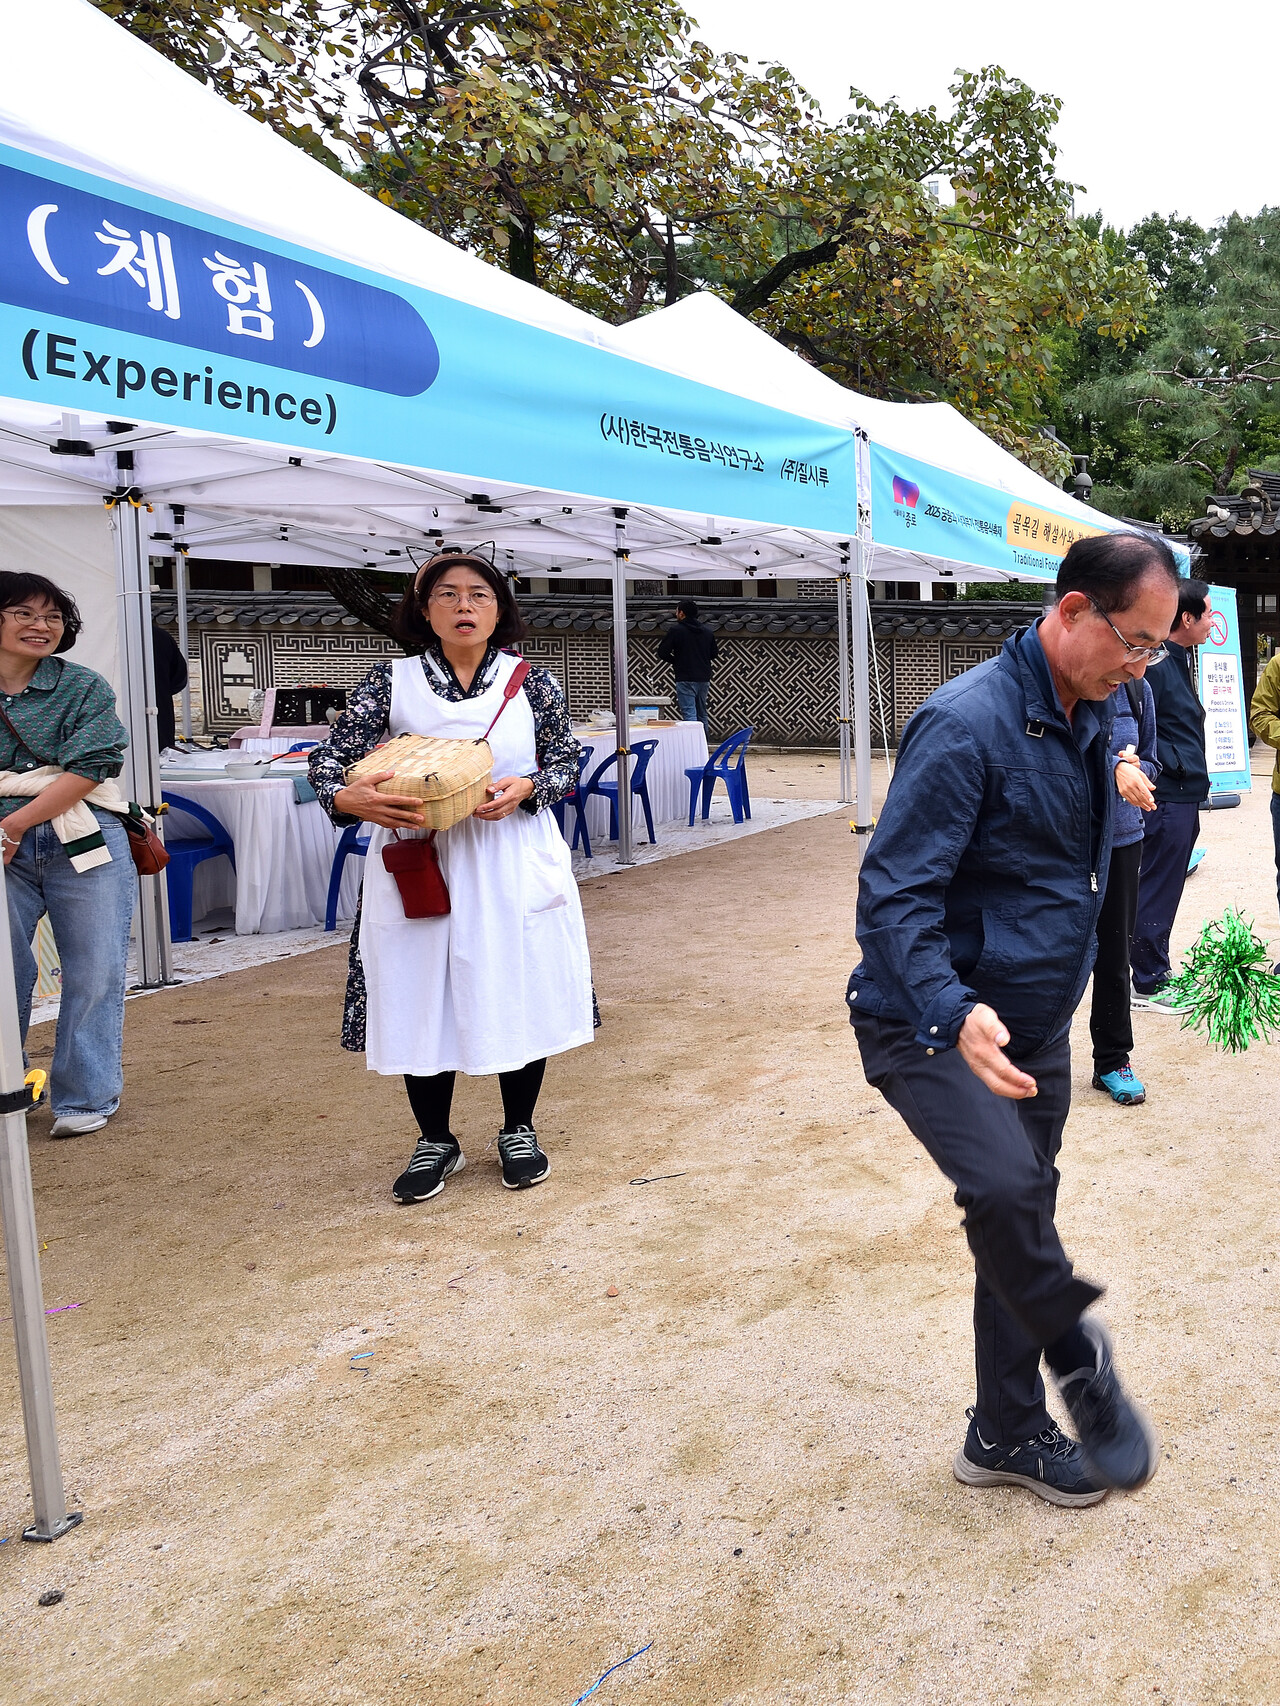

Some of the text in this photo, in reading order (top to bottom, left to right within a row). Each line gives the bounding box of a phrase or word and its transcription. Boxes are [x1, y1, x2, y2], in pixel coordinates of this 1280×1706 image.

[22, 329, 337, 435] (Experience)
[600, 413, 830, 488] (사)한국전통음식연구소 (주)질시루
[905, 512, 917, 528] 종로
[924, 503, 941, 518] 2025
[1012, 513, 1040, 539] 골목길
[1043, 523, 1075, 546] 해설사와
[1013, 550, 1059, 572] Traditional Food
